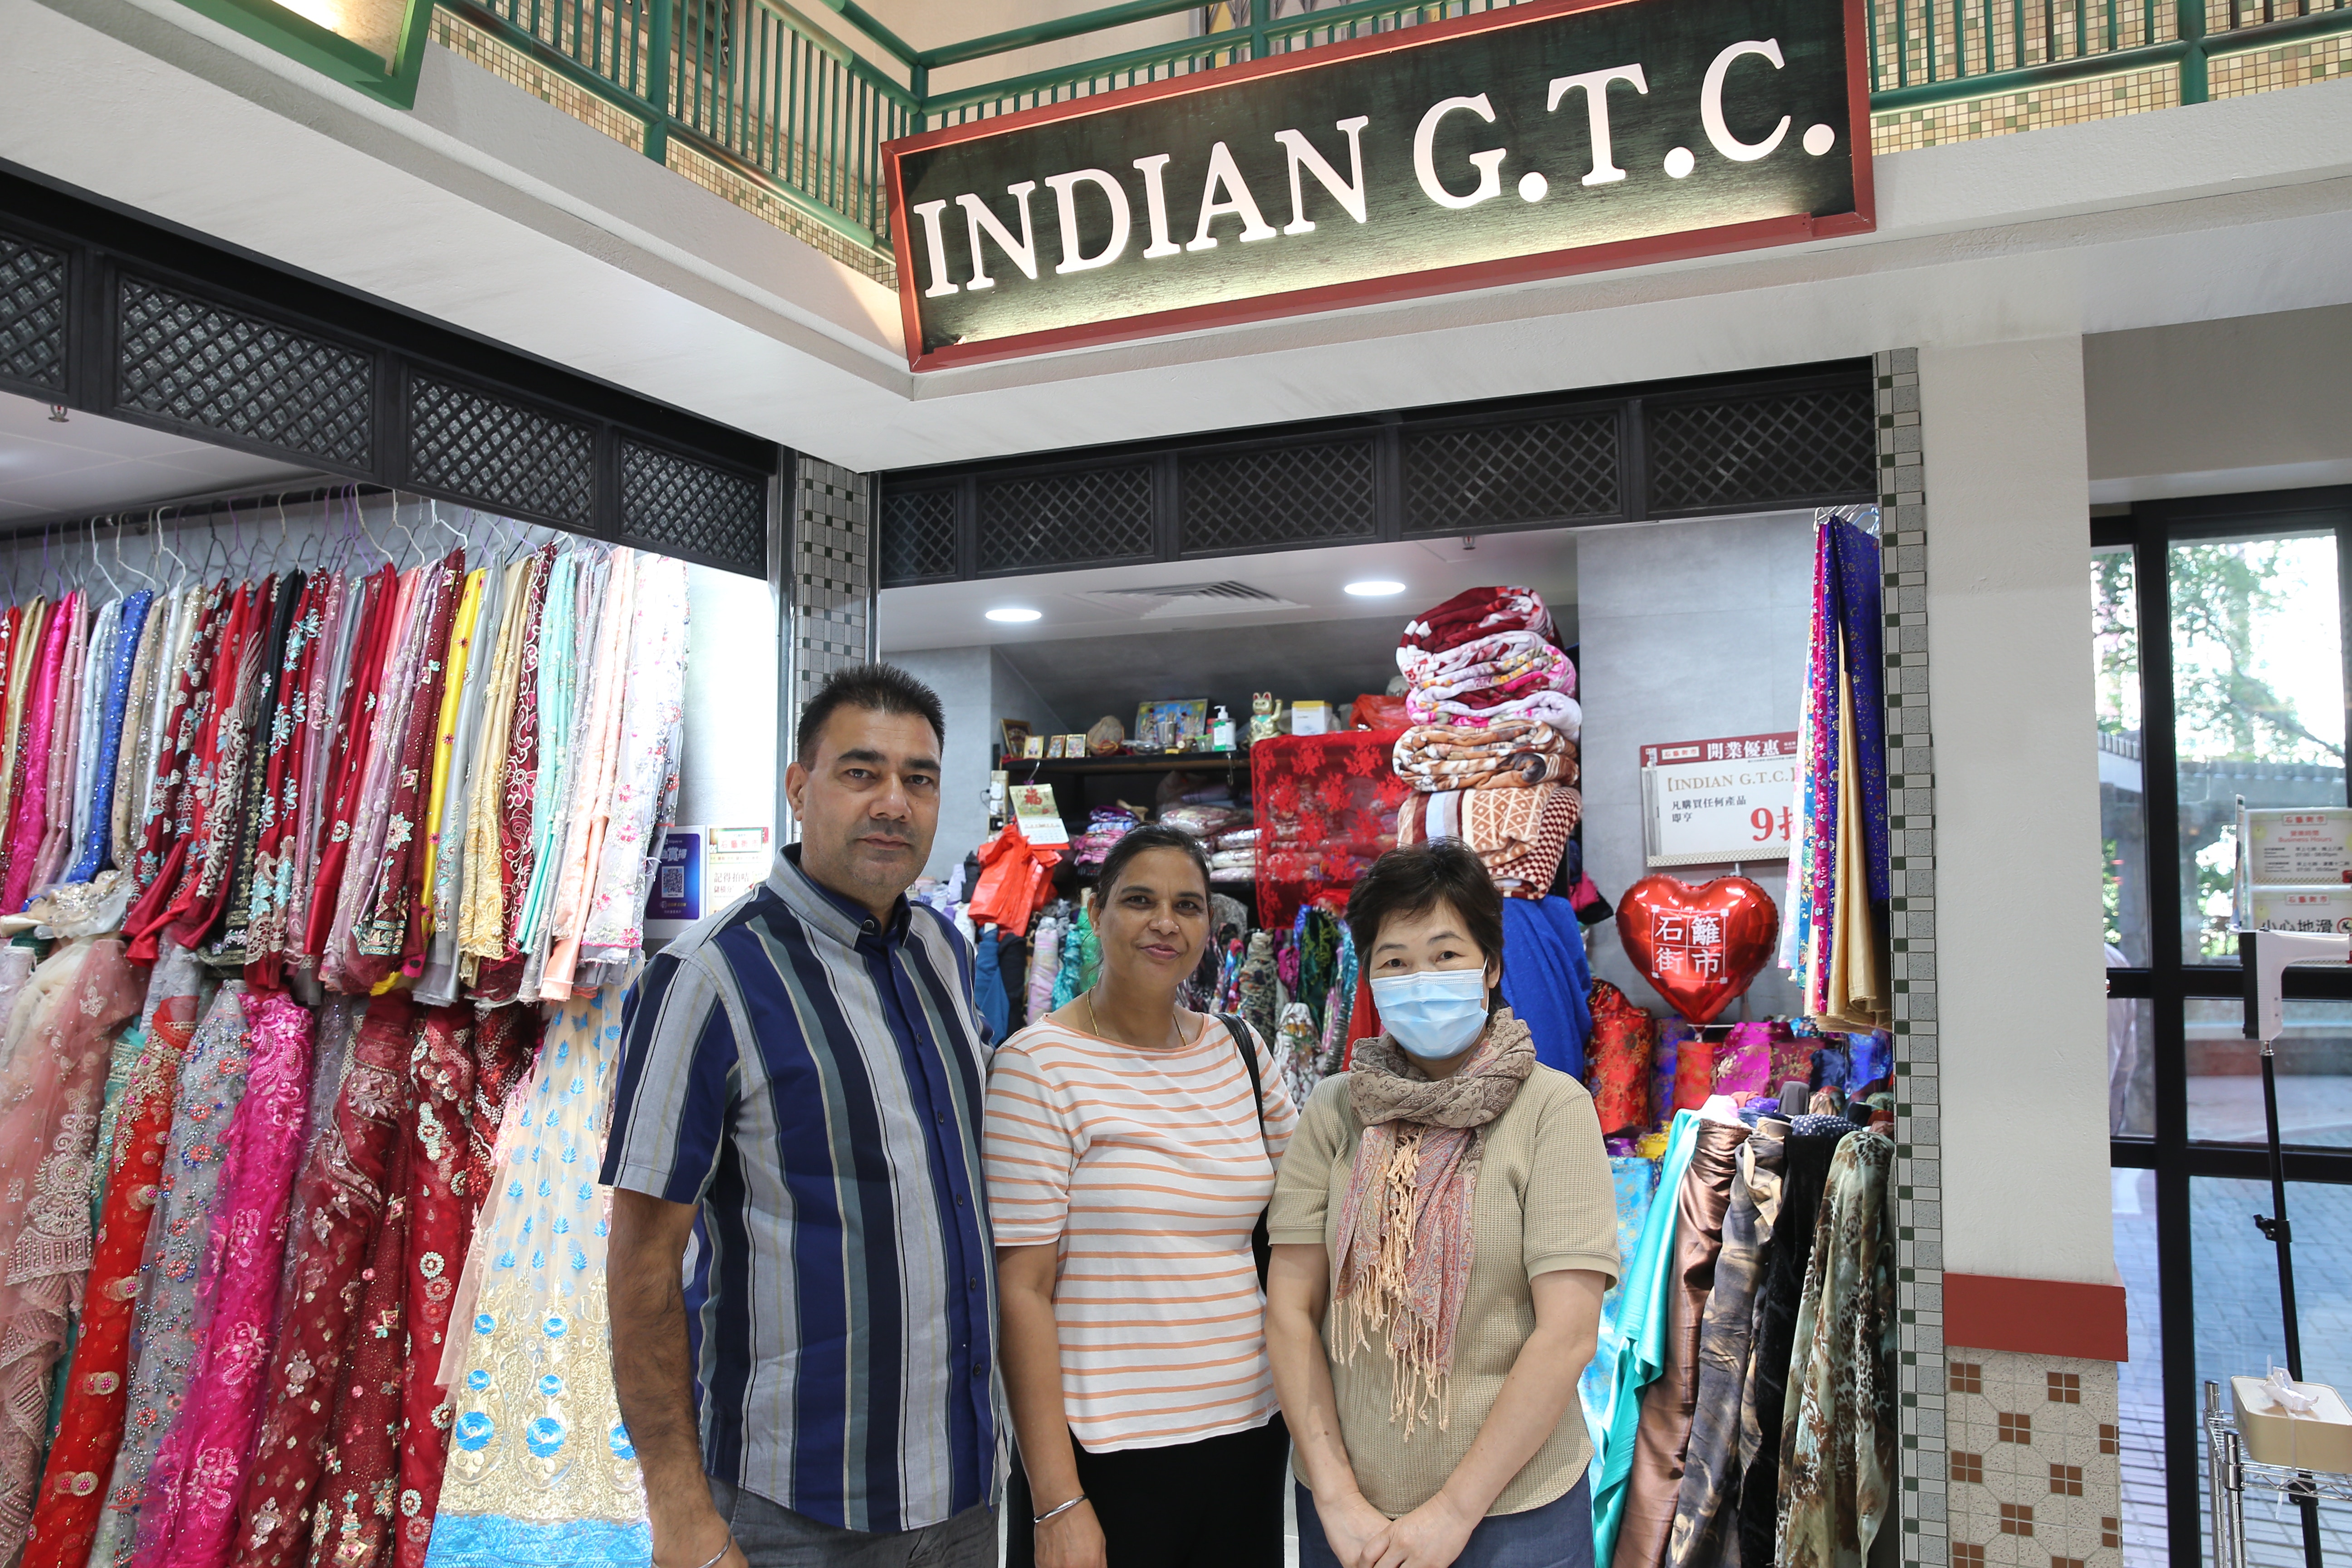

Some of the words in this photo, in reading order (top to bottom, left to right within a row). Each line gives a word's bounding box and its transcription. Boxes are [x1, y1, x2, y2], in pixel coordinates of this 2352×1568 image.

[913, 116, 1368, 298] INDIAN
[1414, 38, 1836, 208] G.T.C.
[1707, 739, 1779, 760] 開業優惠
[1671, 795, 1746, 810] 凡購買任何產品
[2261, 919, 2332, 933] 小心地滑
